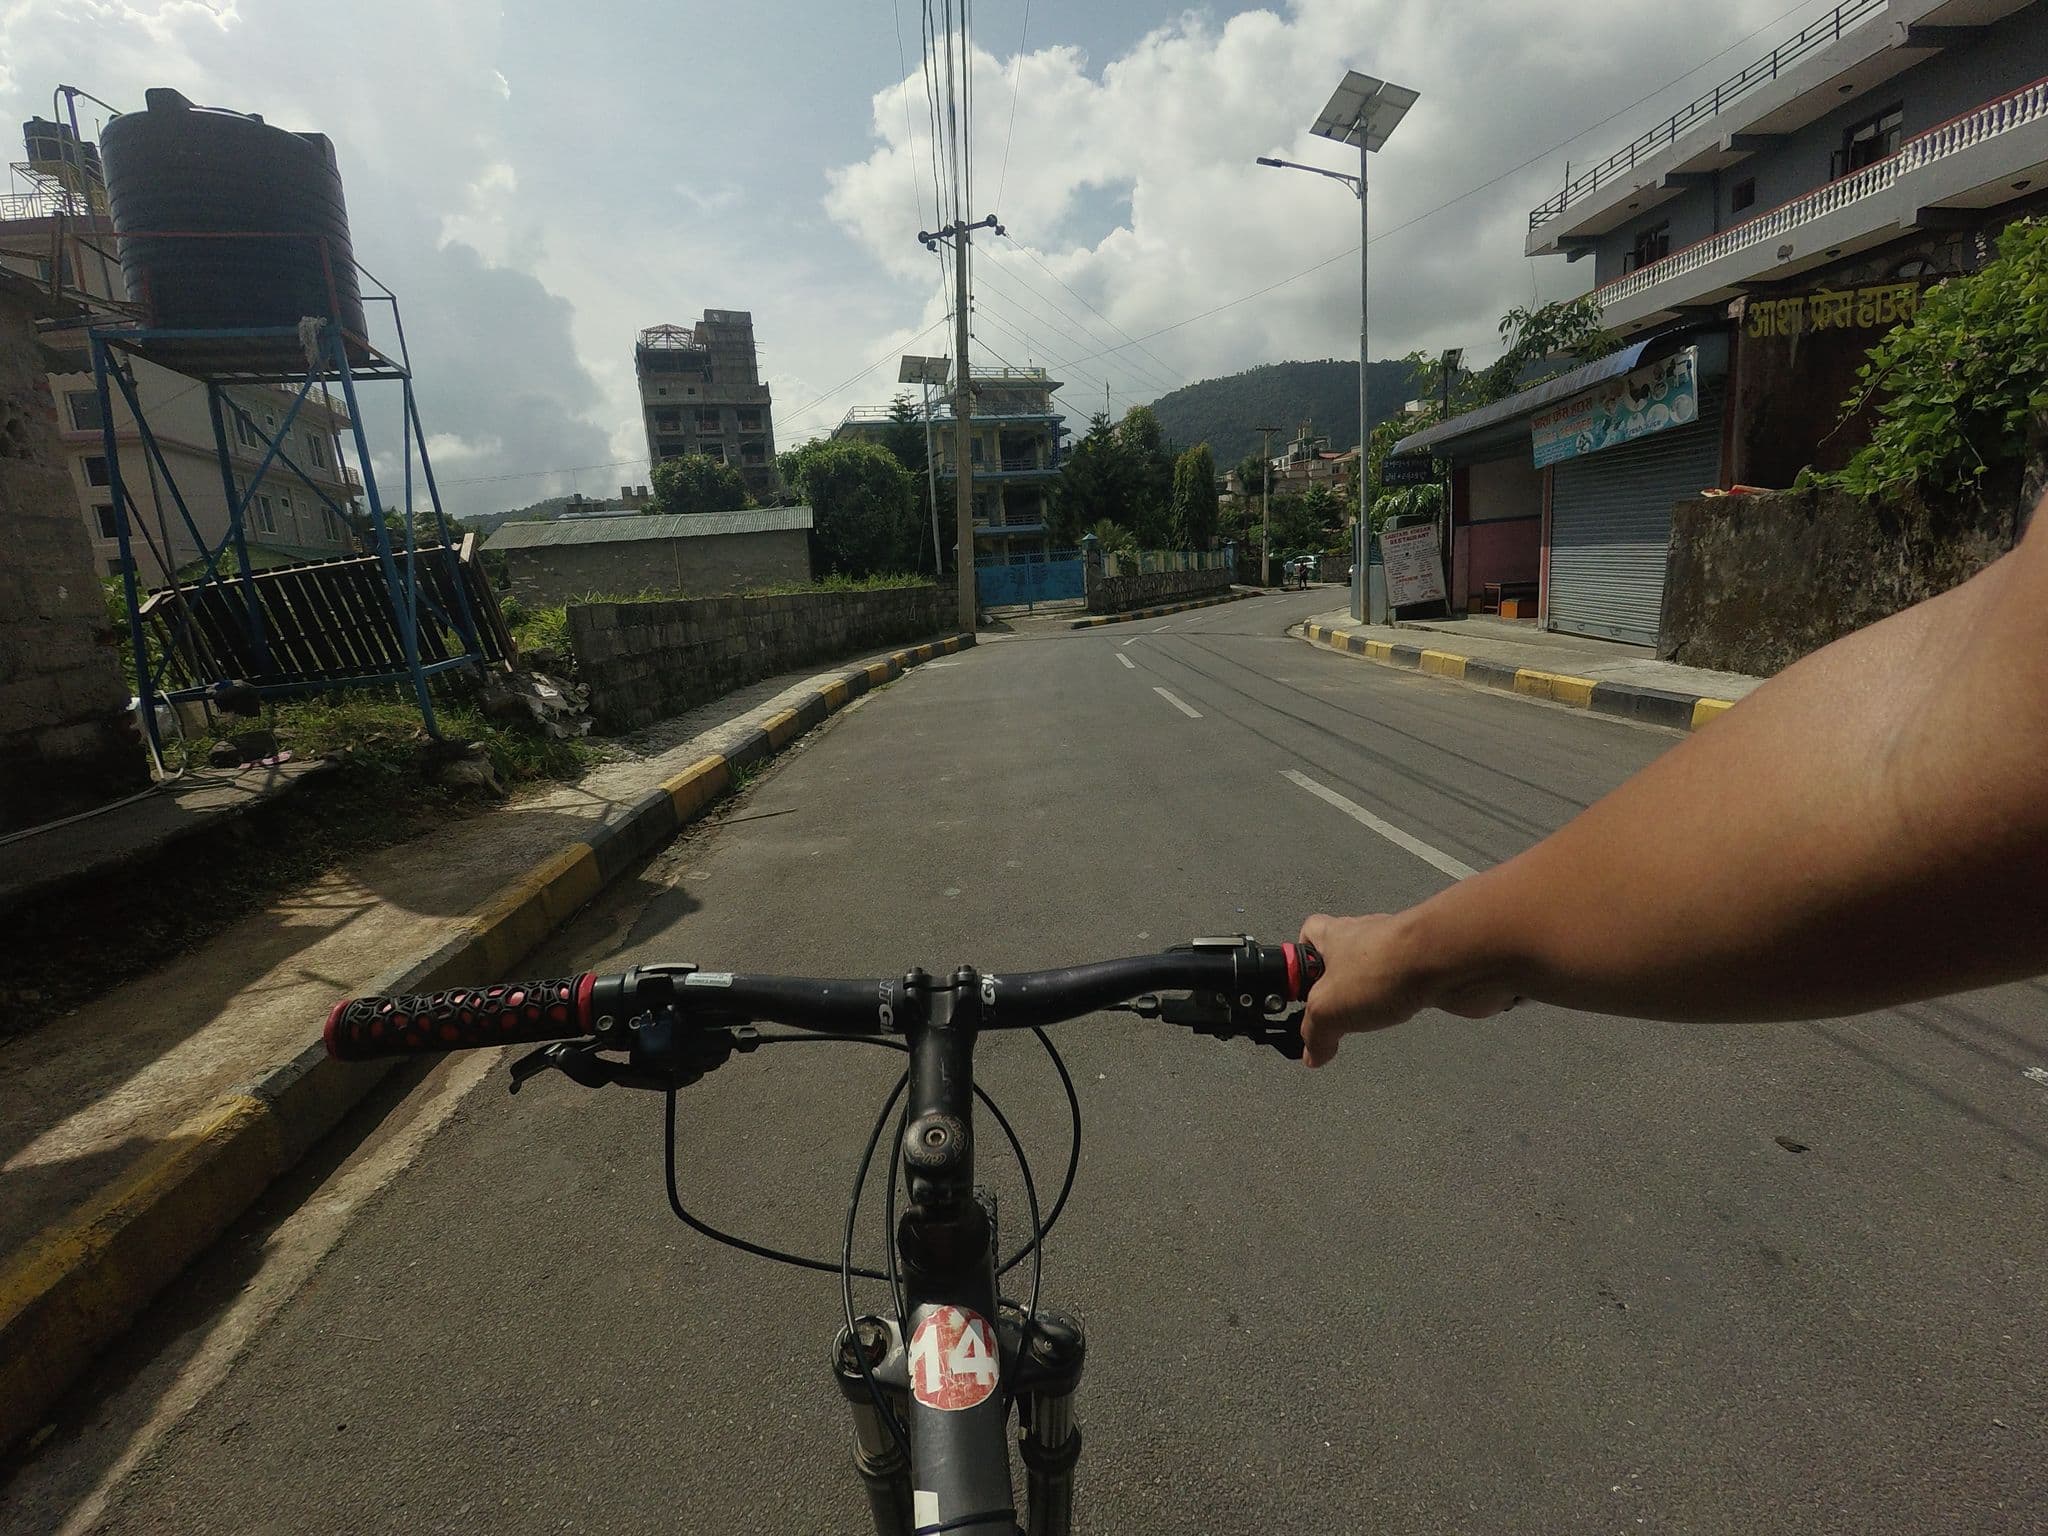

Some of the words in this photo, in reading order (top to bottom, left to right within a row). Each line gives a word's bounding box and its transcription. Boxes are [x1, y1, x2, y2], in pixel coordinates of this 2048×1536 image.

[1748, 297, 1804, 338] आशा
[1856, 282, 1921, 329] हाउस
[909, 1318, 995, 1394] 14
